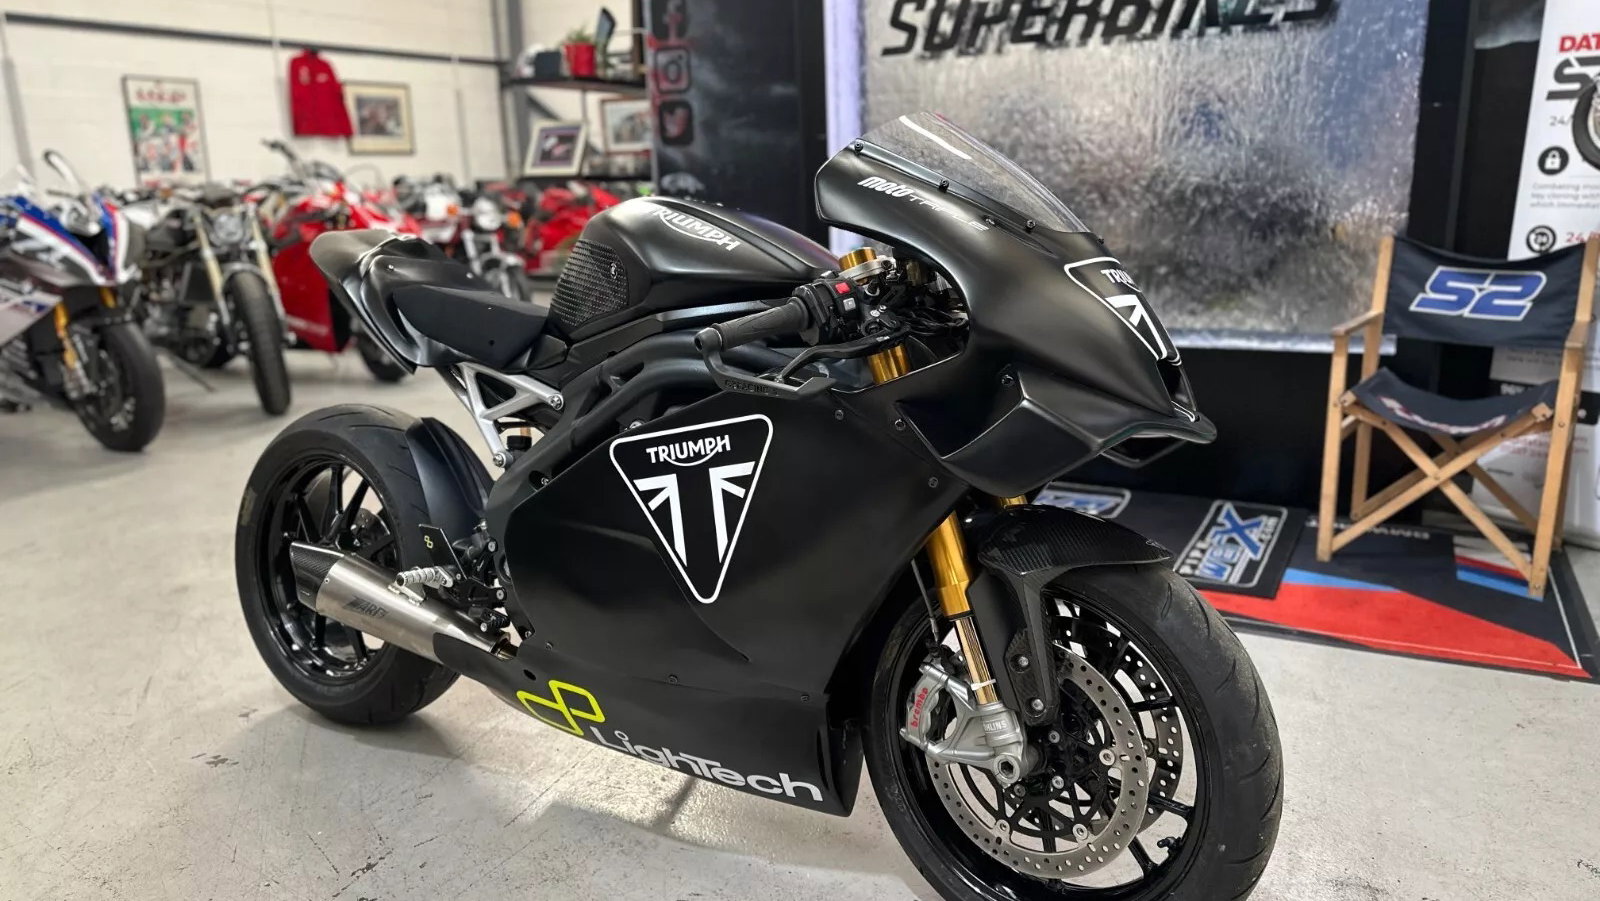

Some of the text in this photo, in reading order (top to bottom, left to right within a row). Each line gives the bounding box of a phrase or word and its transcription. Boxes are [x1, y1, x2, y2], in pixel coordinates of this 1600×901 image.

[1409, 265, 1547, 321] S2
[646, 434, 731, 467] TRIUMPH
[910, 687, 929, 728] brembo
[589, 726, 823, 801] LighTech
